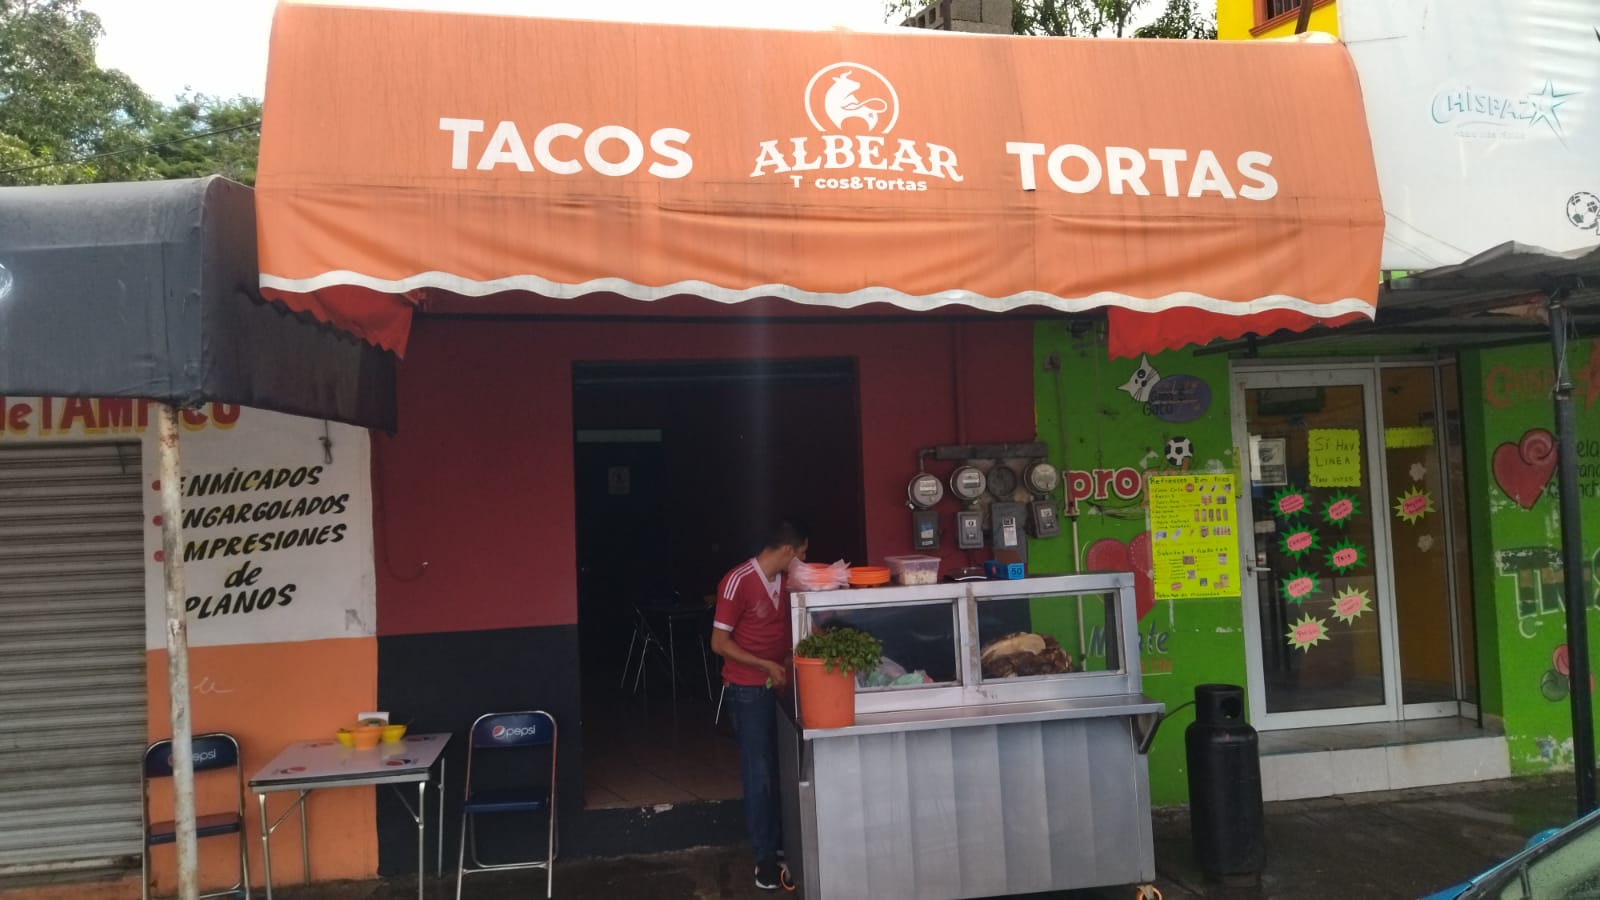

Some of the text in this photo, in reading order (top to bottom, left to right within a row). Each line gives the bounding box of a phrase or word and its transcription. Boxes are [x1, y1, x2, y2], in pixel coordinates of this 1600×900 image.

[439, 117, 694, 179] TACOS
[749, 135, 964, 182] ALBEAR
[1005, 141, 1279, 201] TORTAS
[181, 493, 350, 529] NGARGOLADOS
[183, 523, 347, 562] MPRESIONES
[224, 560, 263, 588] de
[1011, 567, 1023, 576] 50
[506, 724, 537, 739] pepsi
[191, 748, 217, 762] epsi
